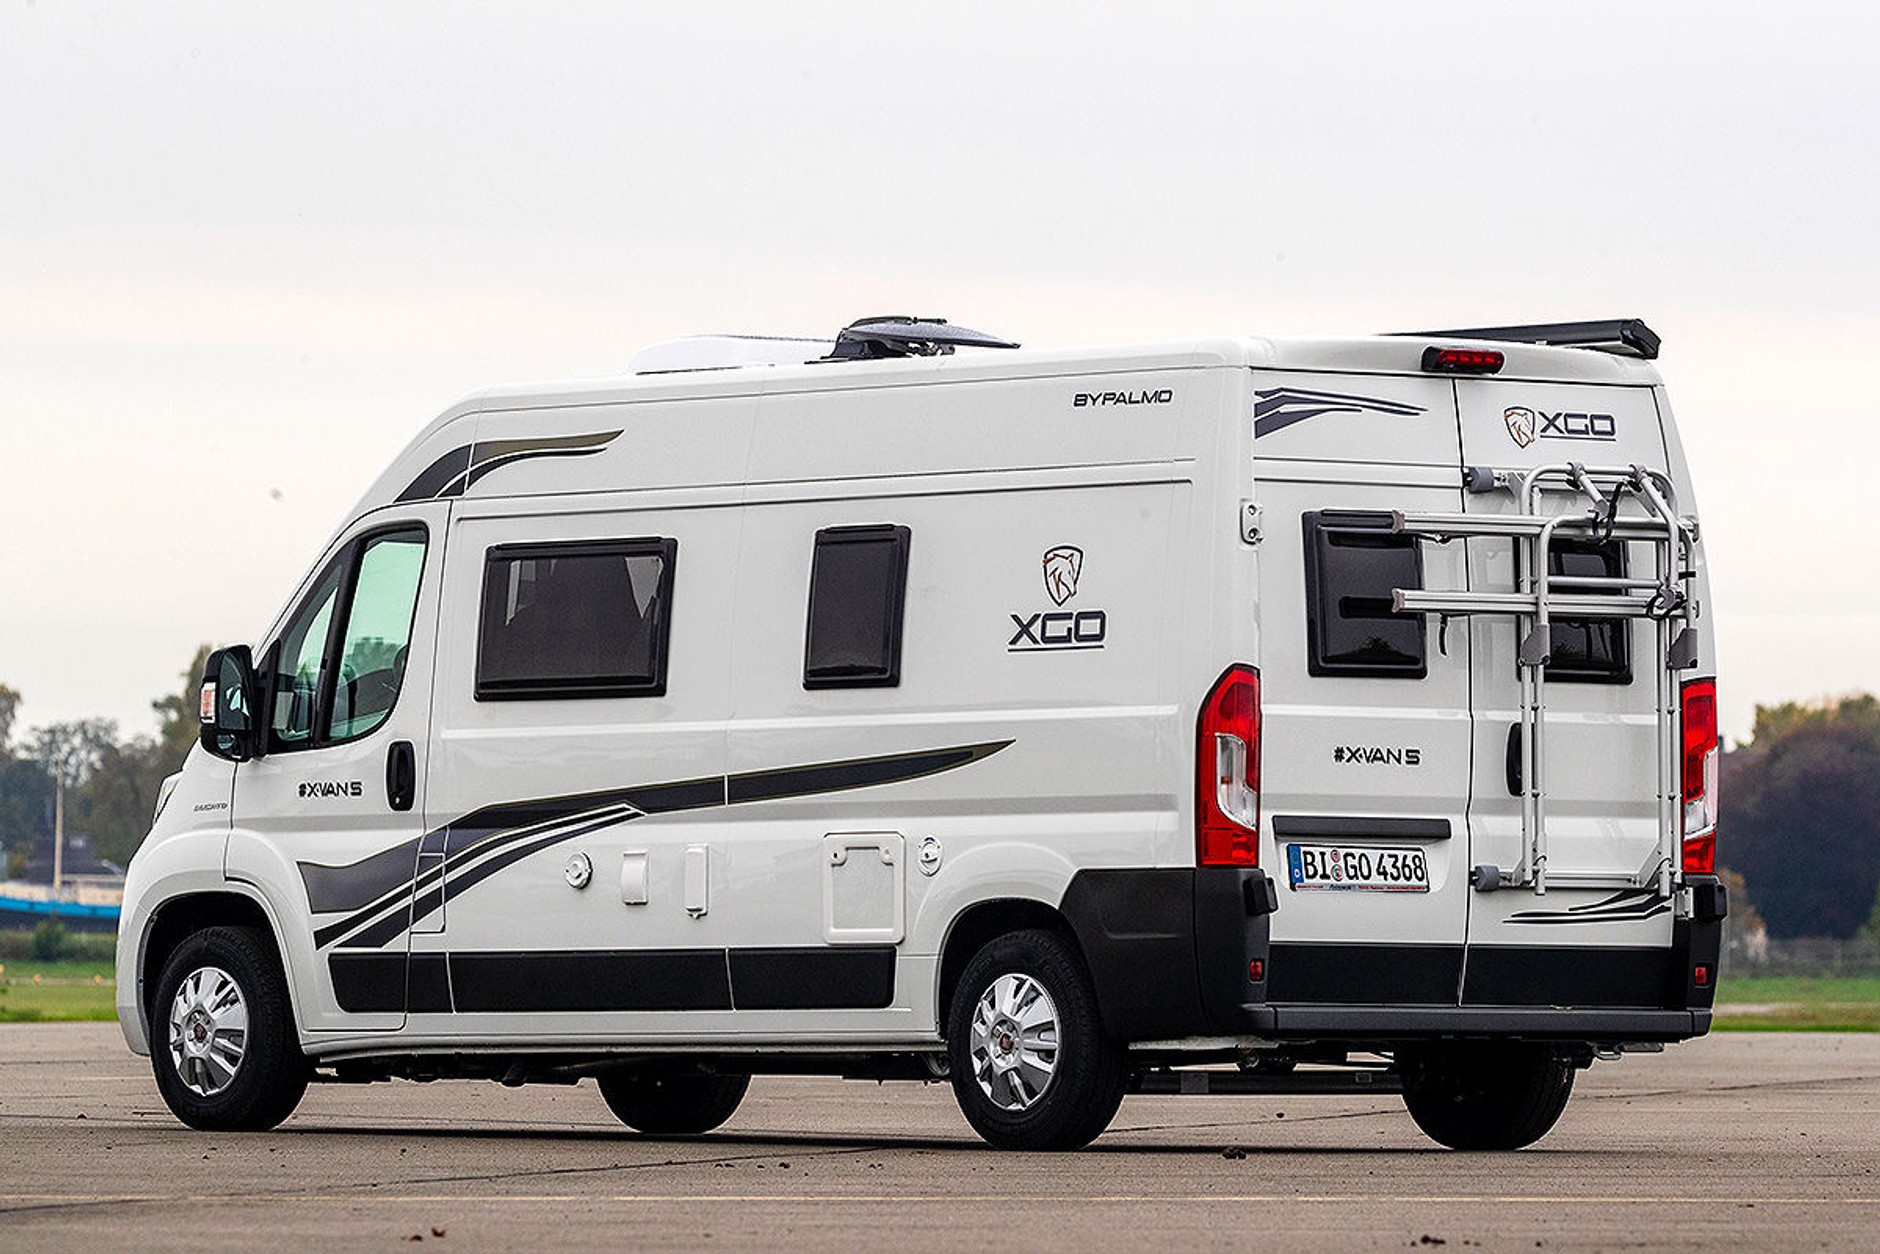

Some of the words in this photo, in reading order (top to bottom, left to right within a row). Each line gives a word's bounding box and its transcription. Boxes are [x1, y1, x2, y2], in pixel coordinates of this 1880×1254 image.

[1073, 390, 1173, 407] BYPALMO
[1538, 411, 1616, 437] XGO
[1008, 610, 1106, 645] XGO
[1302, 851, 1331, 880] BI
[1342, 852, 1372, 881] GO
[1376, 853, 1425, 882] 4368
